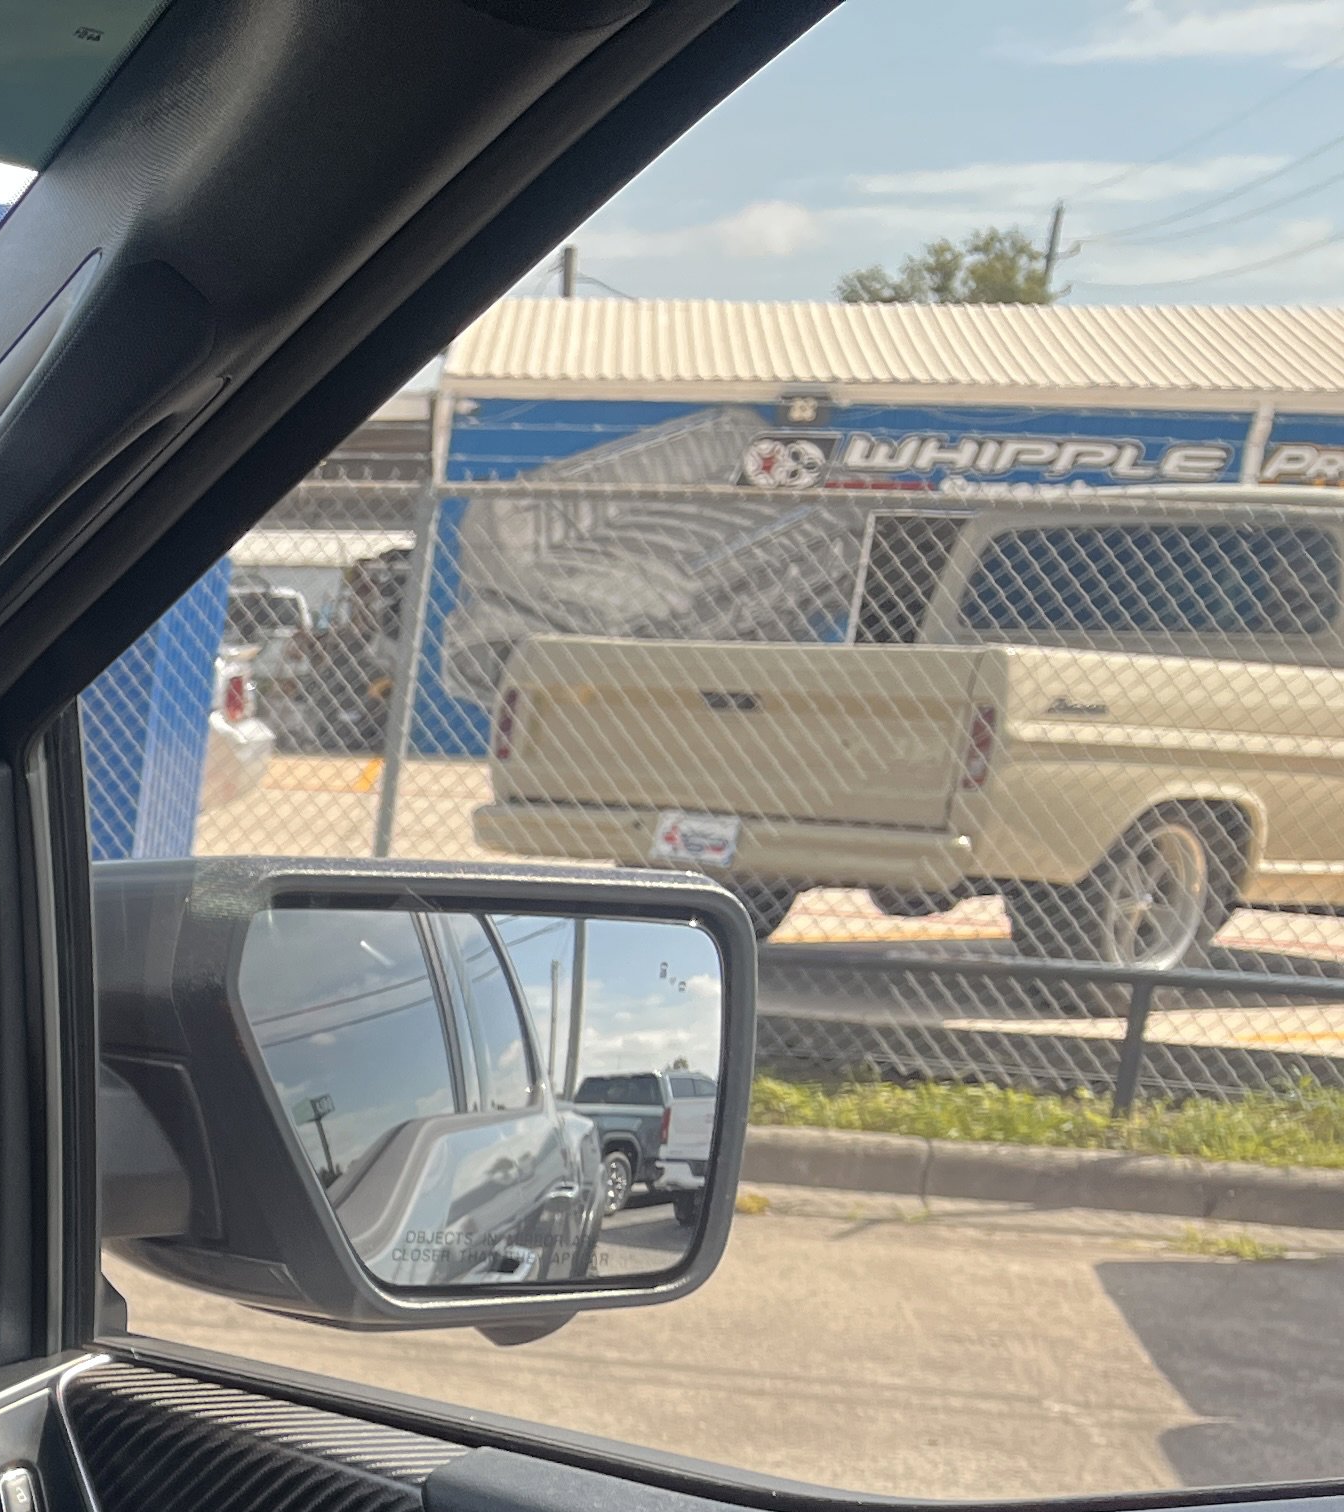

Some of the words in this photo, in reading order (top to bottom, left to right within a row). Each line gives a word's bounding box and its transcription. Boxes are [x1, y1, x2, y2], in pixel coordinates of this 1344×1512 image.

[841, 433, 1229, 479] WHIPPLE
[405, 1230, 475, 1246] OBJECTS
[392, 1247, 451, 1263] CLOSER
